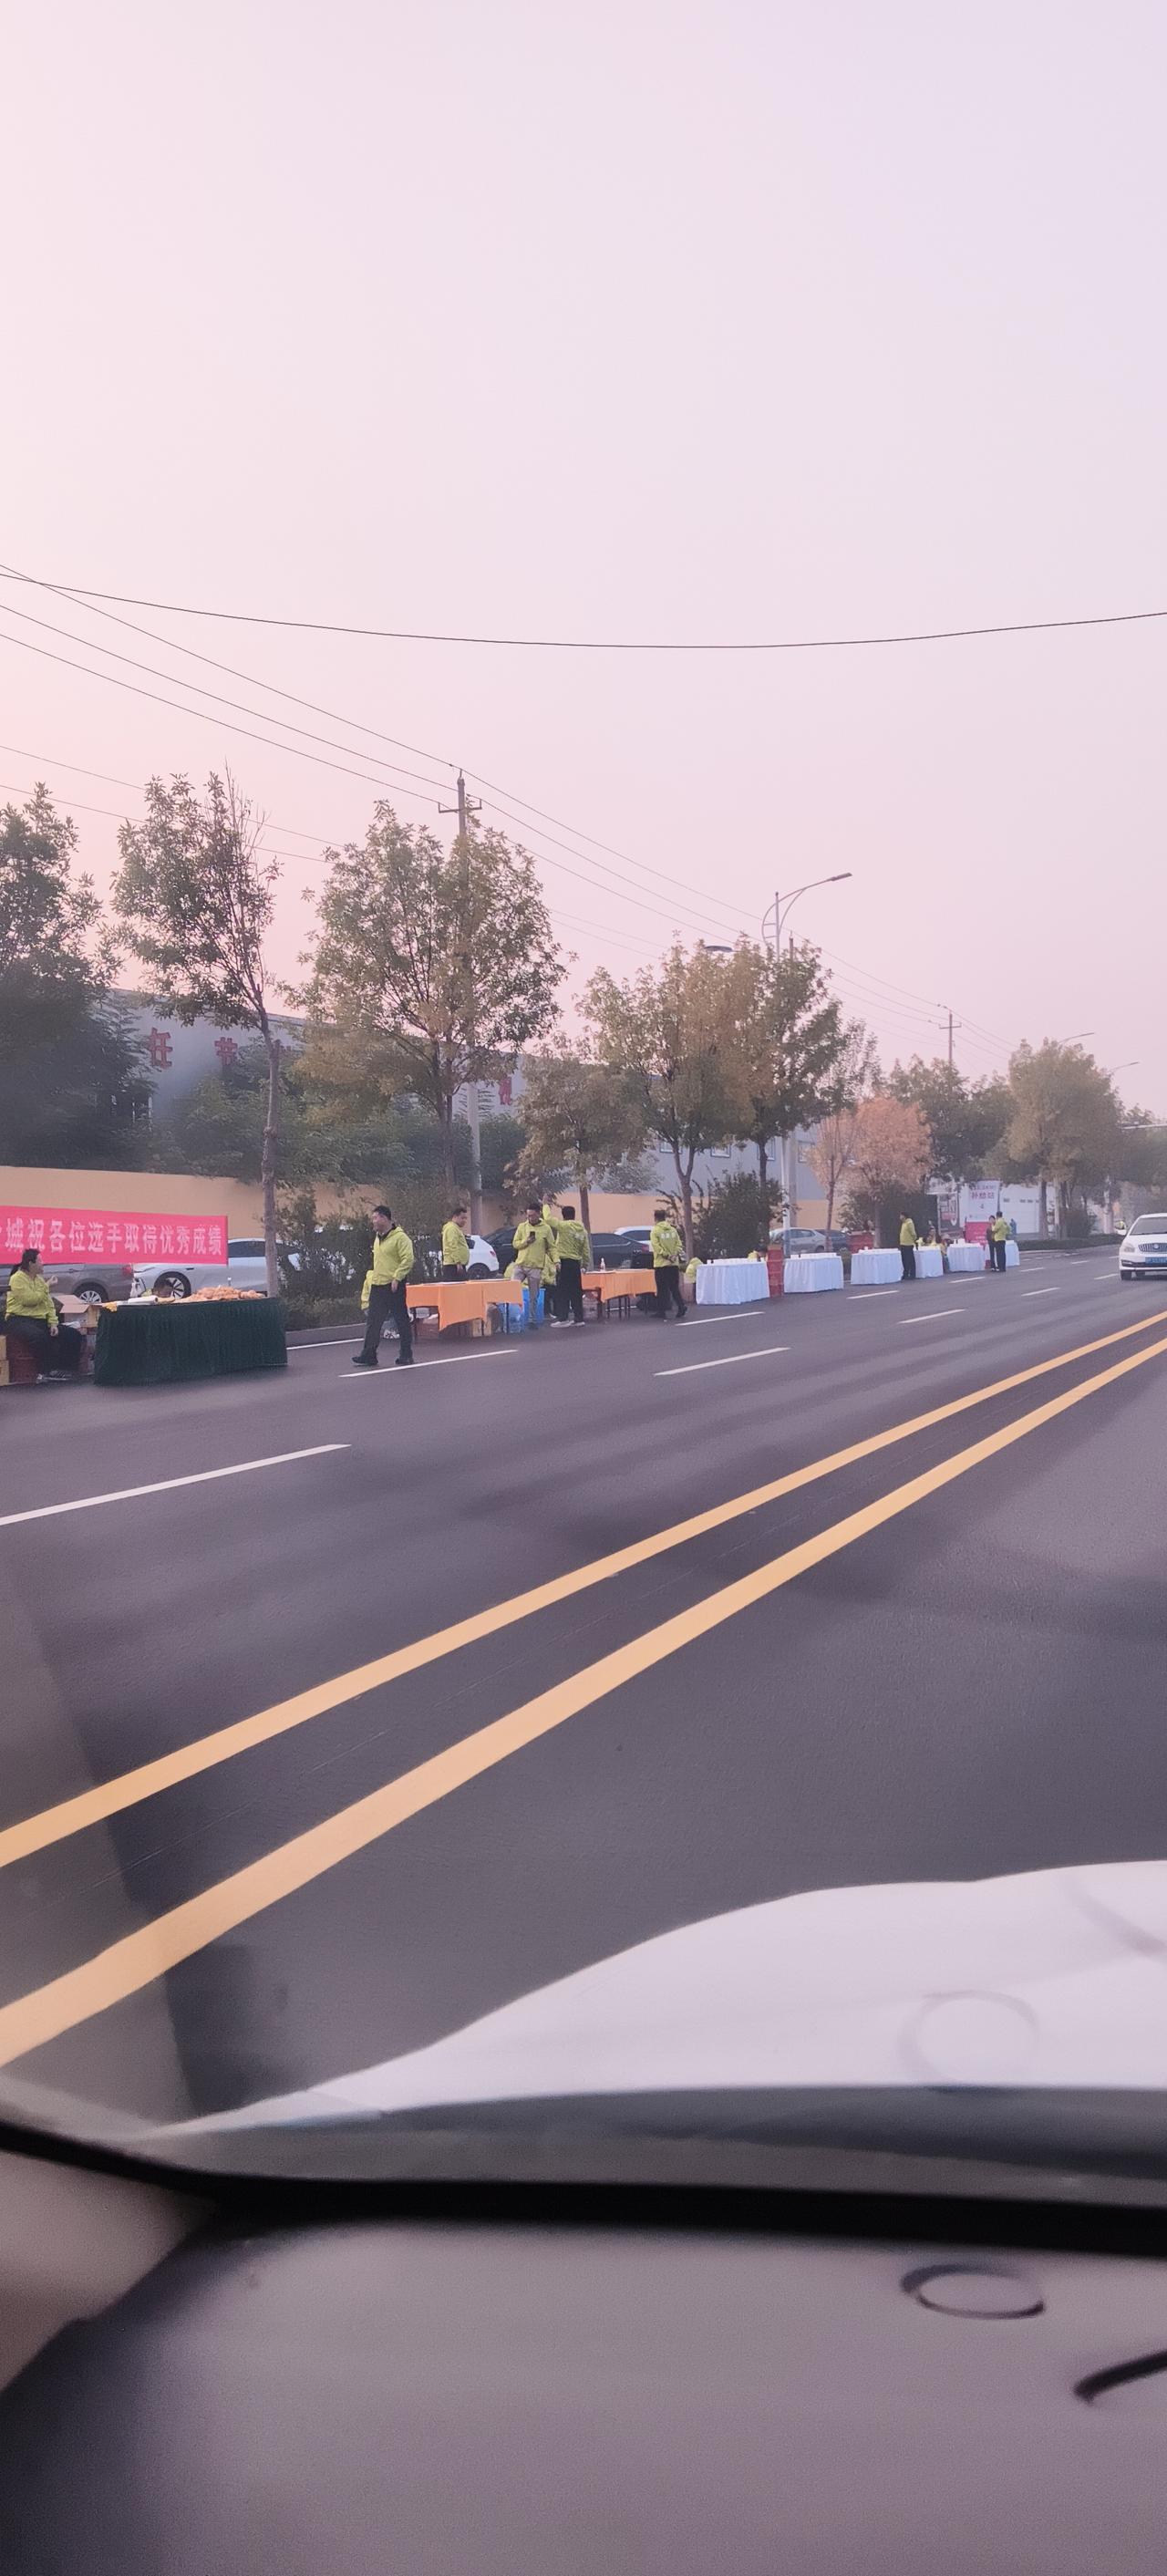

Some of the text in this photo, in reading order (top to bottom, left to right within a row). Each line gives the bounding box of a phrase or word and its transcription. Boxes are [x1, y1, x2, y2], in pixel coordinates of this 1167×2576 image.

[0, 1217, 222, 1256] 城祝各位选手取得优秀成绩
